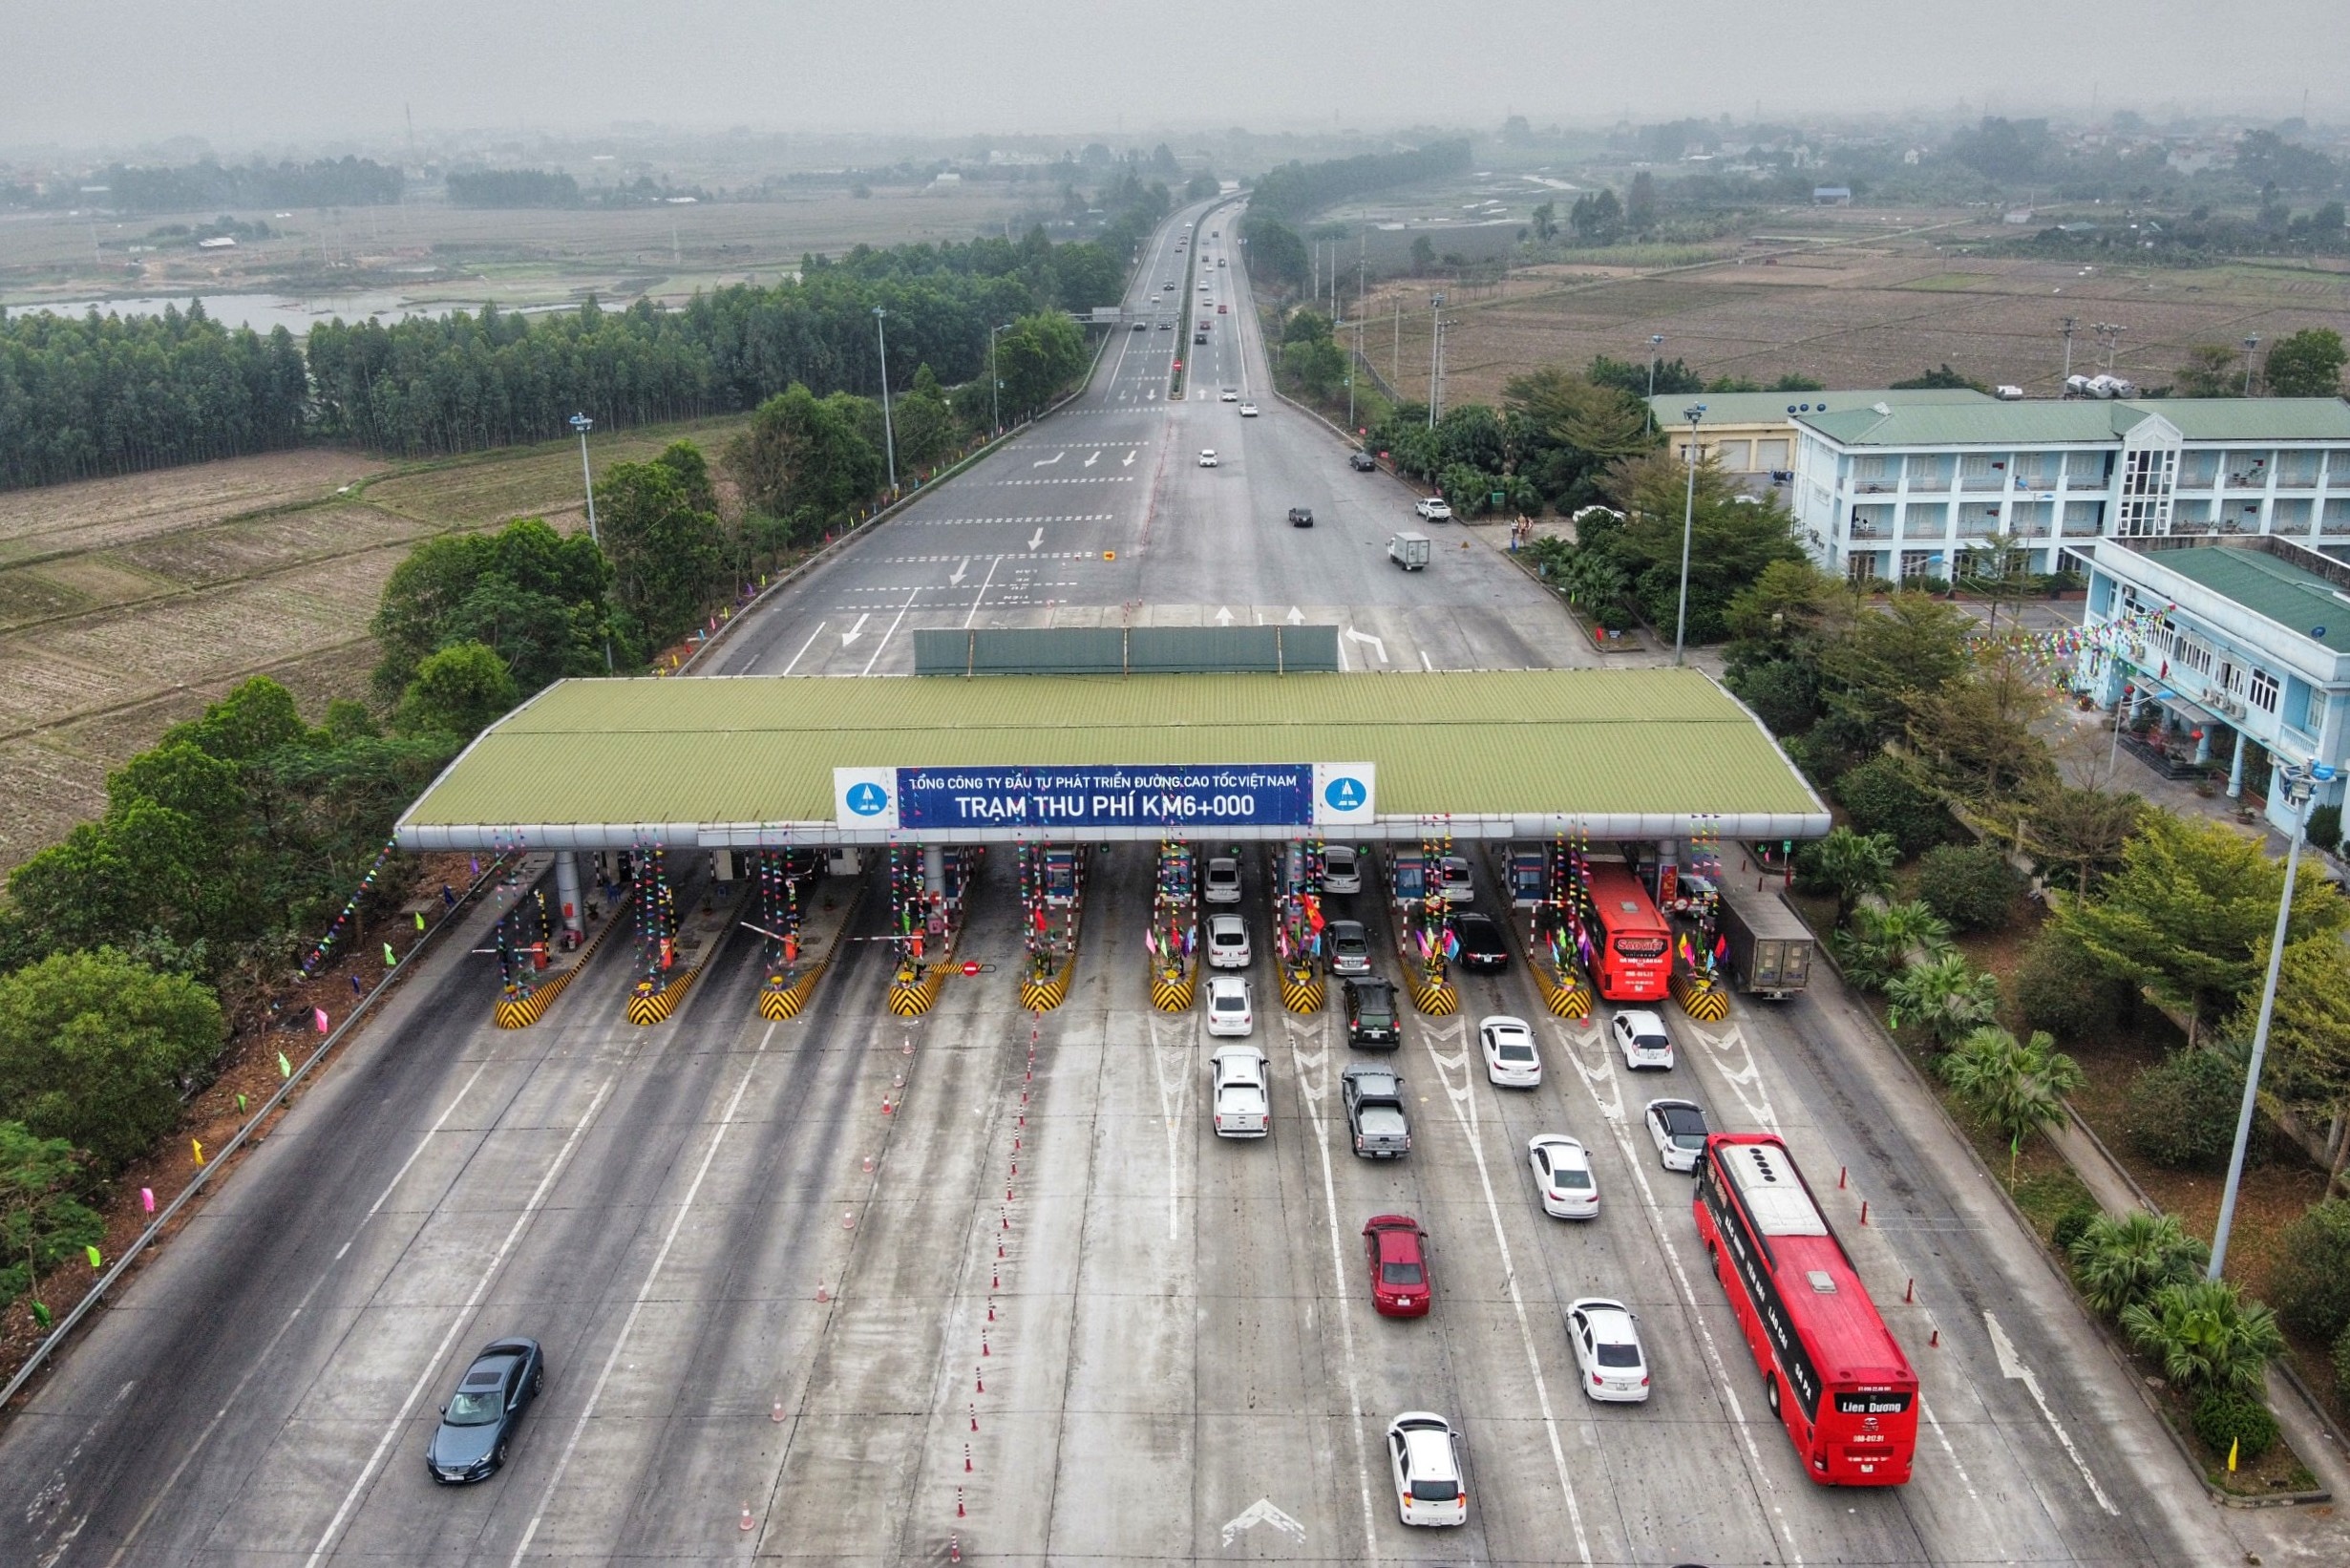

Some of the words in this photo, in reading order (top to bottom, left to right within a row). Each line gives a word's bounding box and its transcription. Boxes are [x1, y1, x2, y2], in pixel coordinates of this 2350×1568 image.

[909, 773, 945, 790] TỔNG
[947, 774, 984, 790] CÔNG
[985, 776, 1002, 789] TY
[1005, 773, 1032, 790] ĐẦU
[1035, 775, 1053, 789] TƯ
[1056, 773, 1090, 789] PHÁT
[1093, 771, 1131, 789] TRIỂN
[1134, 773, 1180, 789] ĐƯỜNG
[1184, 775, 1209, 788] CAO
[1213, 771, 1238, 788] TỐC
[1239, 773, 1266, 790] VIỆT
[1267, 775, 1297, 787] NAM
[954, 796, 1027, 822] TRẠM
[1033, 795, 1085, 817] THU
[1092, 790, 1136, 817] PHÍ
